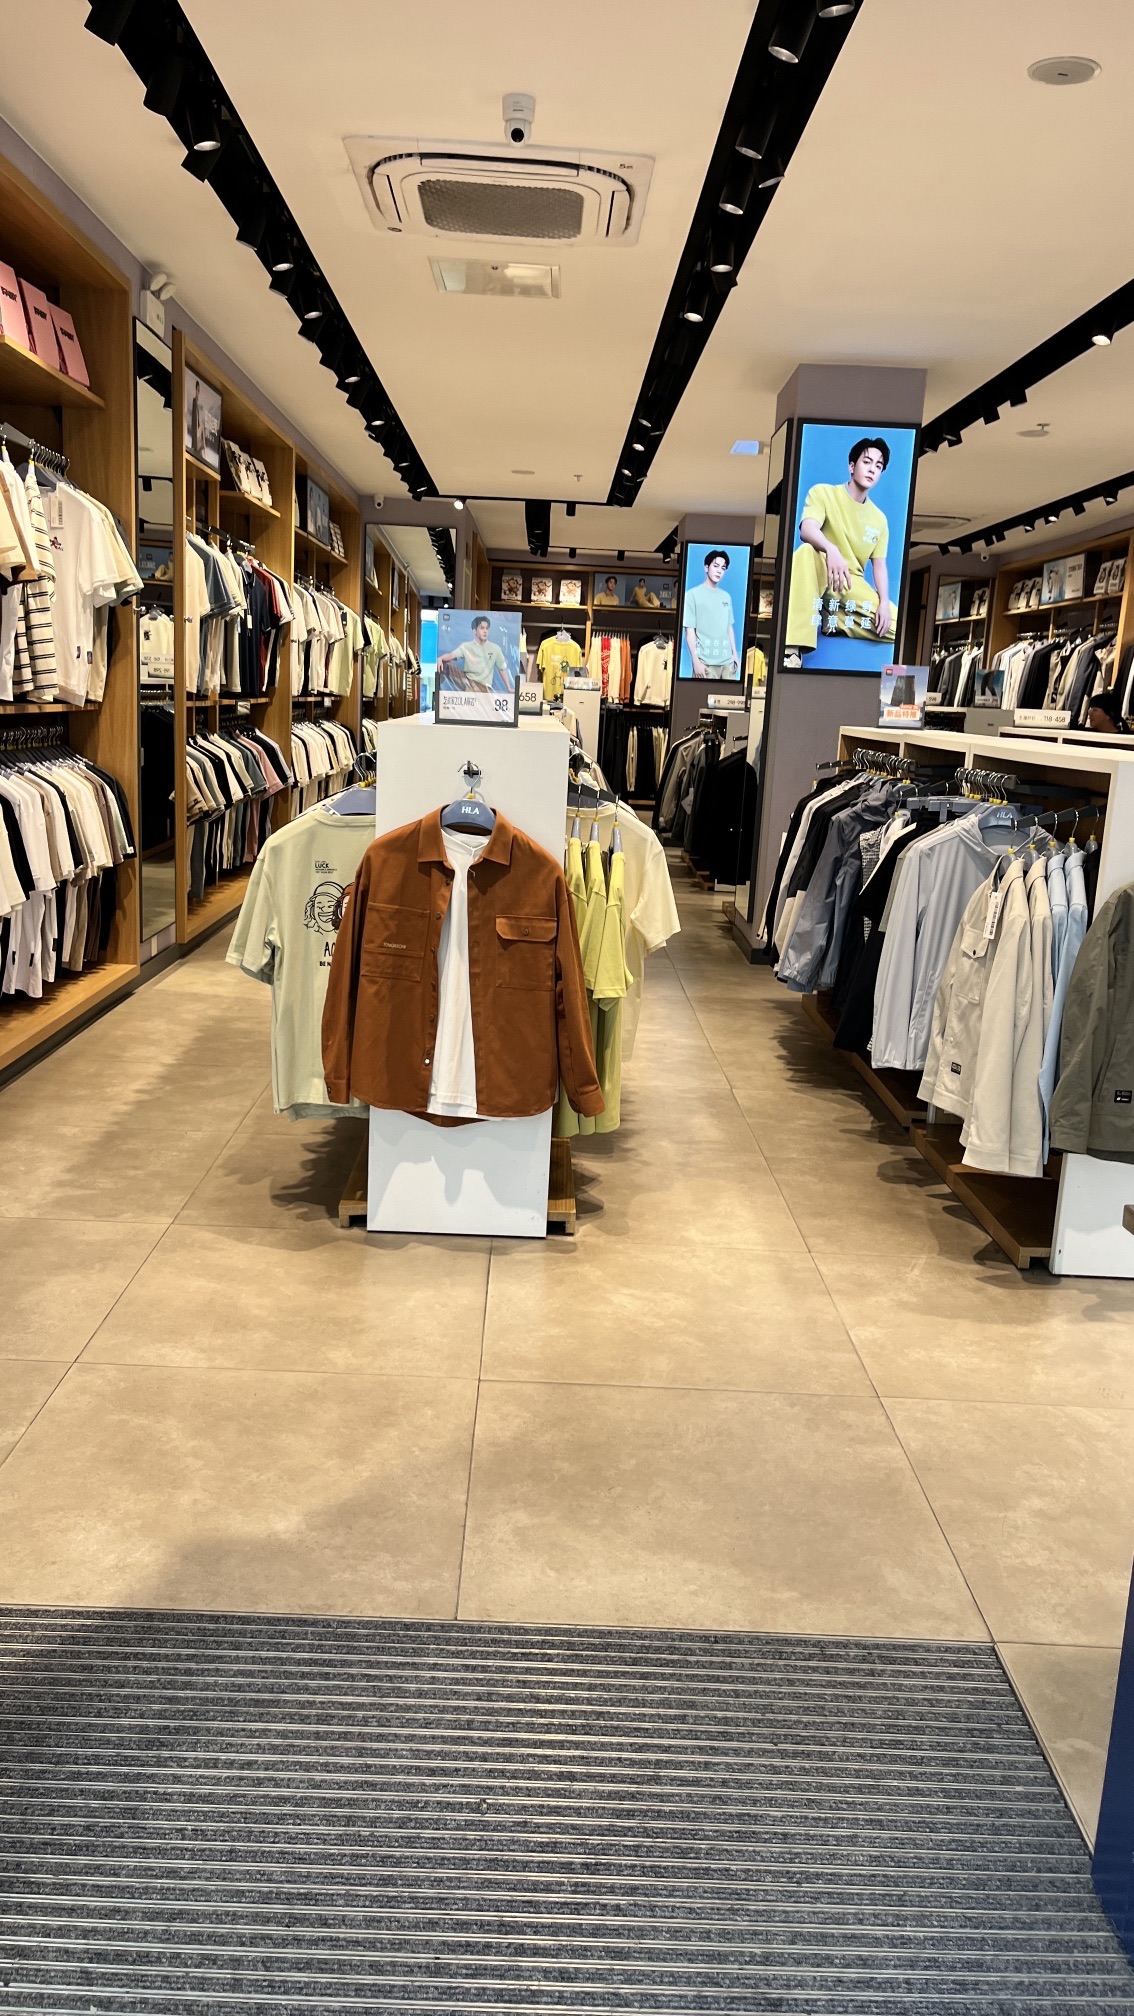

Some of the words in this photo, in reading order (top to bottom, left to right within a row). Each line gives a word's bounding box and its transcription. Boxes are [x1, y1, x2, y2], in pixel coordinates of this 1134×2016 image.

[519, 692, 536, 702] 658
[494, 698, 508, 711] 98
[461, 805, 480, 815] HLA
[996, 811, 1013, 819] HLA
